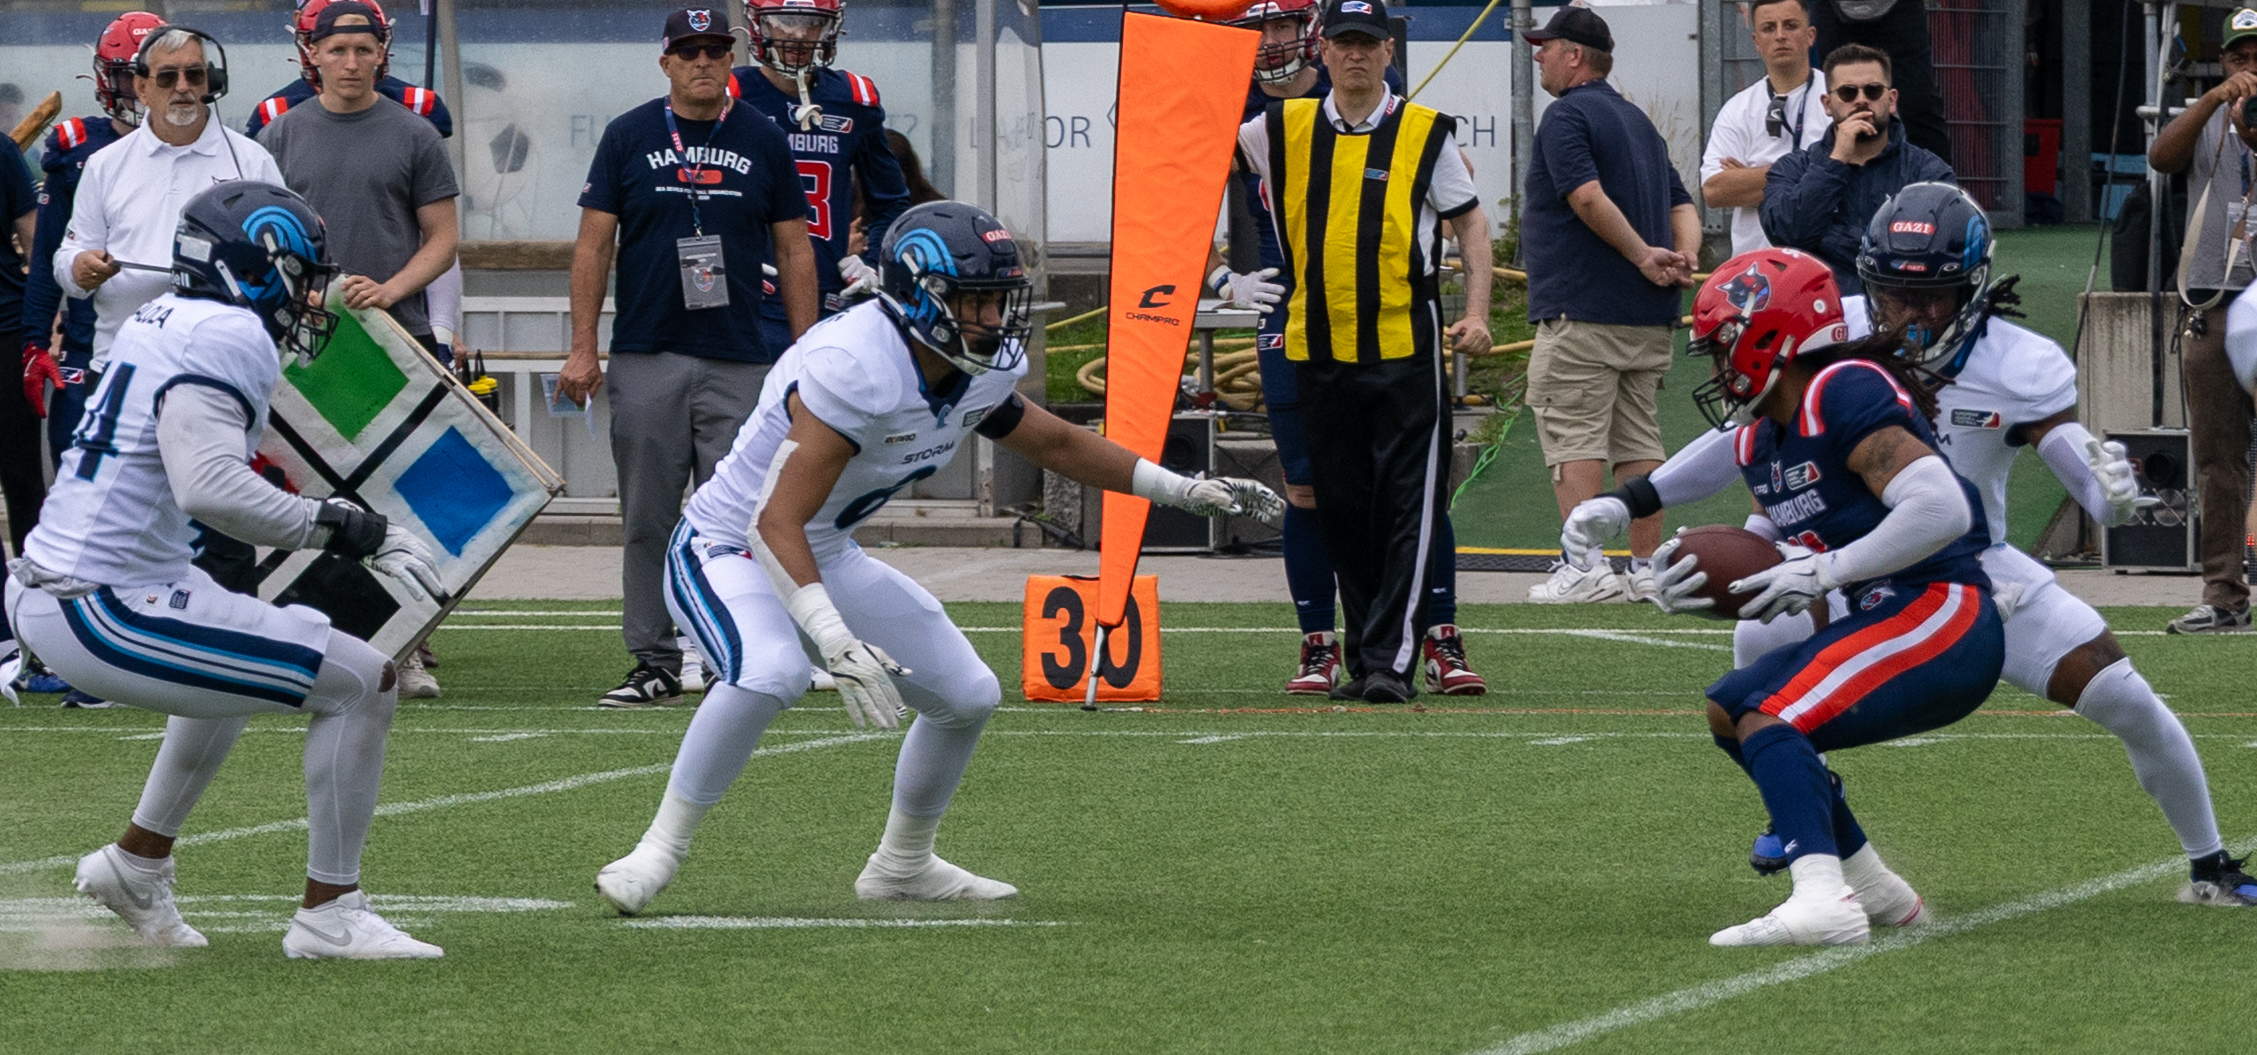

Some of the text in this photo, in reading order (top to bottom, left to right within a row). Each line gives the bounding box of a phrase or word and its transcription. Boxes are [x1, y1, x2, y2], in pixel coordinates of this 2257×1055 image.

[646, 146, 752, 175] HAMBURG
[1893, 222, 1930, 233] GAZI
[1125, 312, 1180, 326] CHAMPRO
[901, 441, 955, 465] STORM
[1041, 586, 1142, 690] 30
